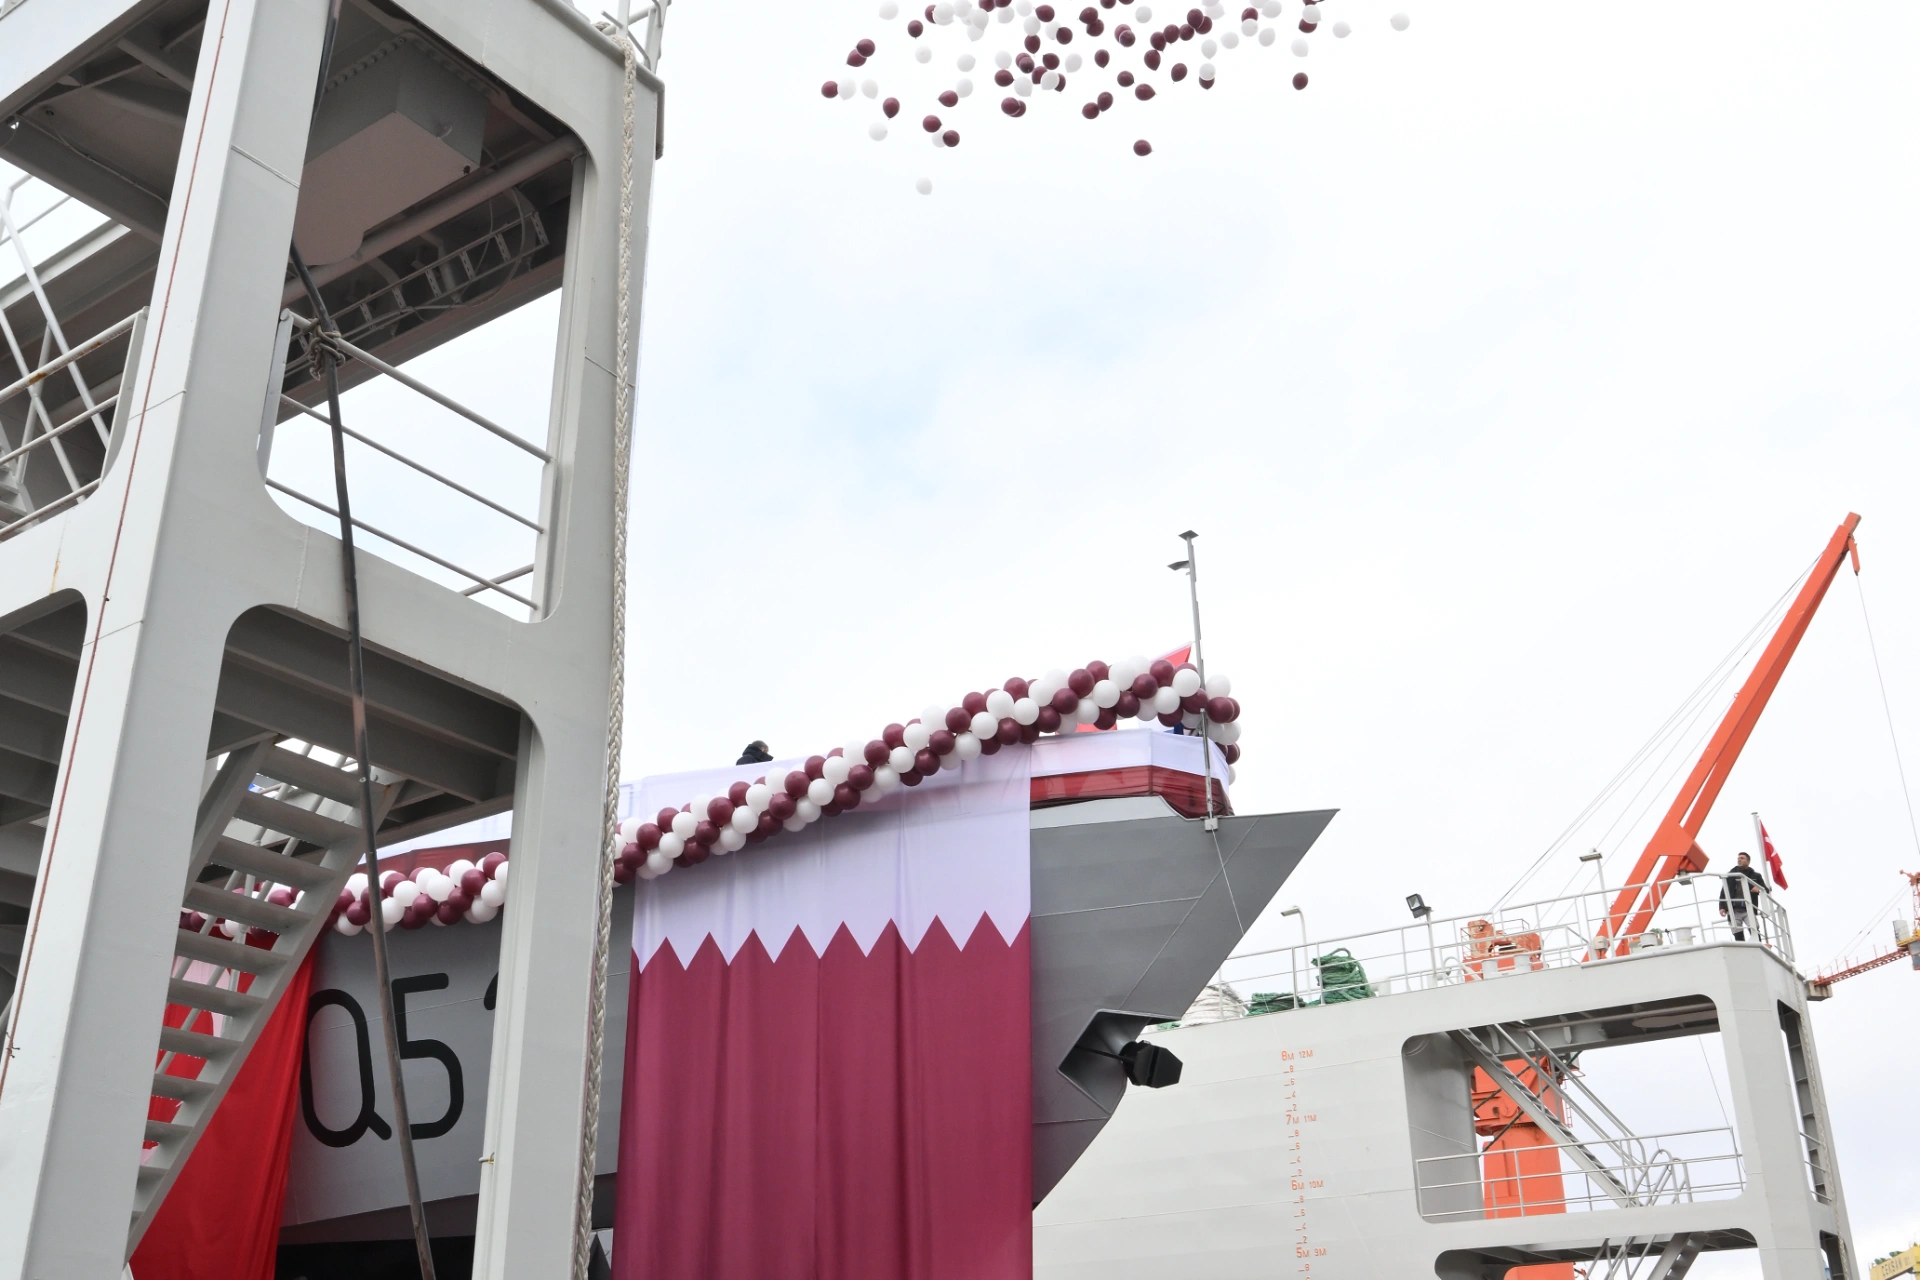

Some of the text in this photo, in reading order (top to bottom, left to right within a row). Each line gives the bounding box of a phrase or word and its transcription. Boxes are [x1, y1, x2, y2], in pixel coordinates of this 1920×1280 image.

[299, 971, 499, 1148] Q5
[1281, 1049, 1313, 1061] 8M 12M
[1286, 1113, 1317, 1124] 7M 11M
[1291, 1179, 1324, 1190] 6M 10M
[1296, 1246, 1327, 1258] 5M 9M
